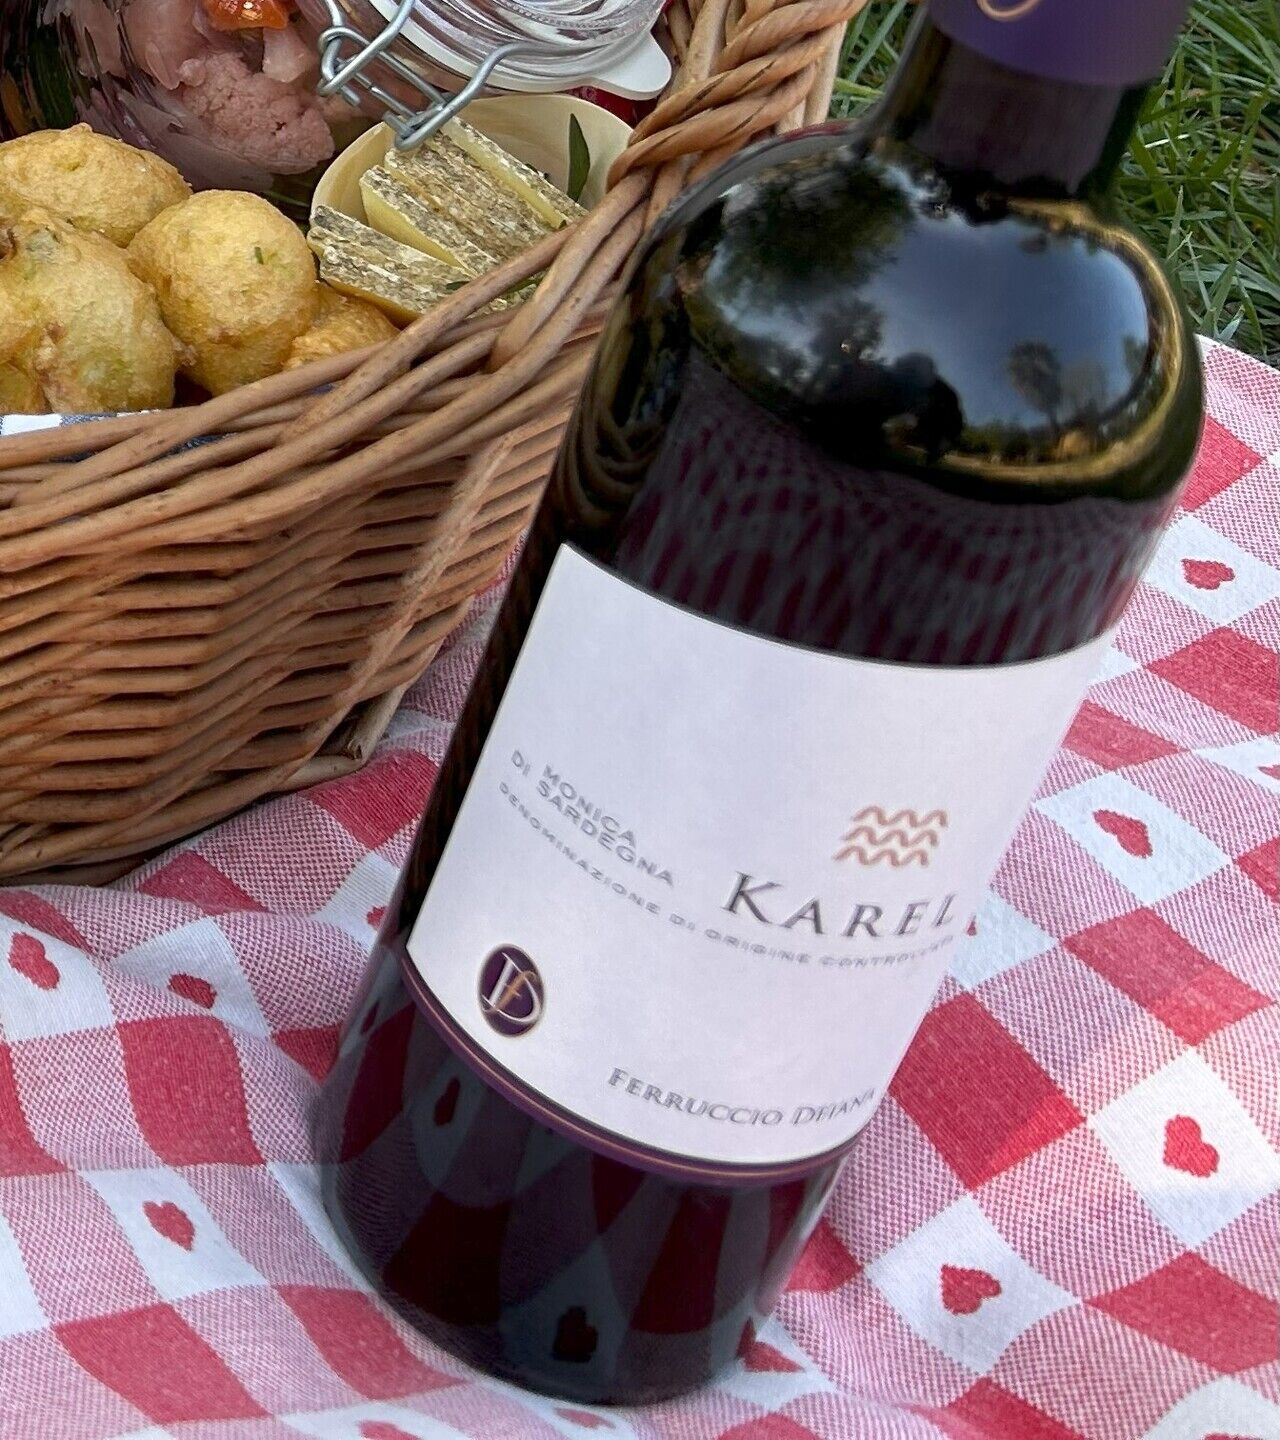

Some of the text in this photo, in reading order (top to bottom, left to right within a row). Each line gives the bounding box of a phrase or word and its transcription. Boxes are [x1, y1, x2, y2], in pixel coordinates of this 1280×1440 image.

[498, 781, 661, 916] DENOMINAZIONE
[510, 749, 675, 888] DI SARDEGNA
[542, 764, 637, 848] MONICA
[607, 1067, 784, 1127] FERRUCCIO
